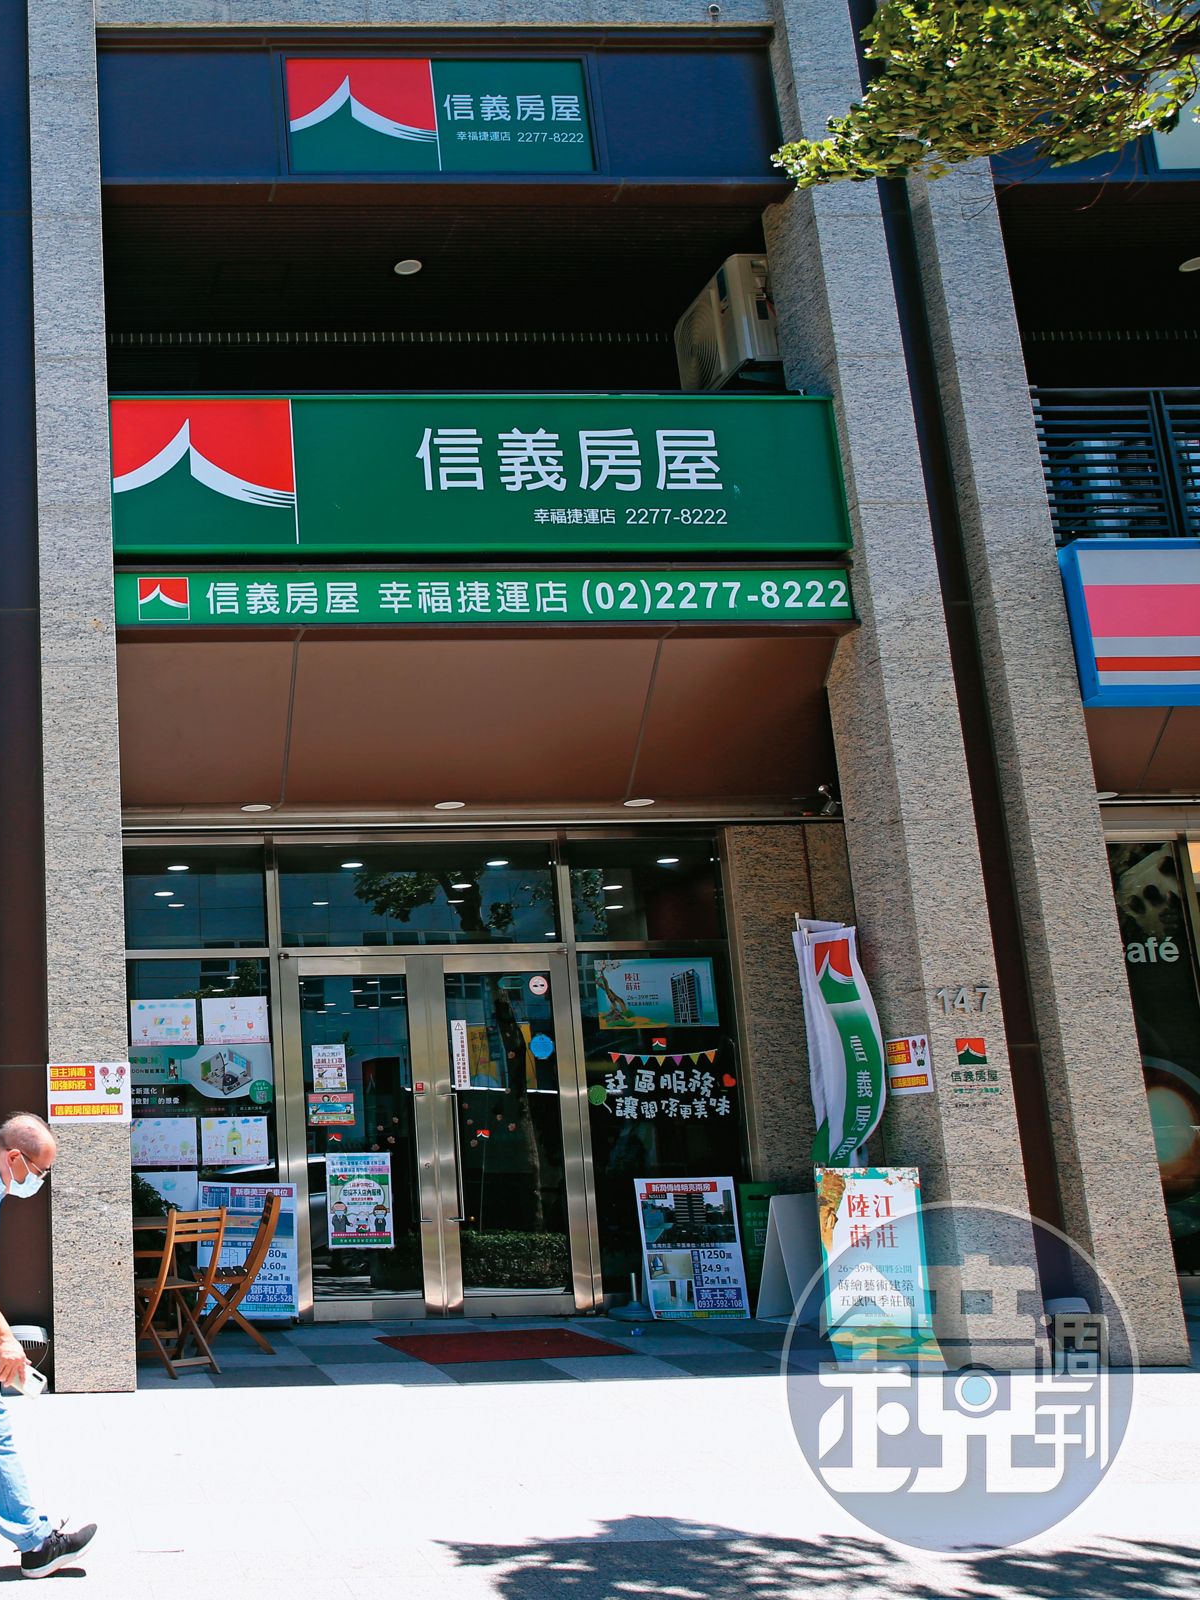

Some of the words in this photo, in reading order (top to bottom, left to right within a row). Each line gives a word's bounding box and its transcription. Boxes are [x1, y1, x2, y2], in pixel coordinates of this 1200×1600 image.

[443, 94, 582, 122] 信義房屋
[456, 131, 511, 142] 幸福捷運店
[517, 132, 584, 143] 2277-8222
[416, 427, 724, 493] 信義房屋
[534, 509, 616, 525] 幸福捷運店
[626, 509, 728, 526] 2277-8222
[207, 582, 358, 614] 信義房屋
[378, 581, 568, 614] 幸福捷運店
[583, 579, 848, 614] (02)2277-8222
[1123, 936, 1179, 963] afé
[937, 987, 991, 1014] 147
[604, 1069, 715, 1097] 社區服務
[951, 1069, 999, 1082] 信義房屋
[616, 1096, 731, 1119] 讓關係更美味
[847, 1193, 896, 1218] 陸江
[268, 1250, 288, 1259] 80萬
